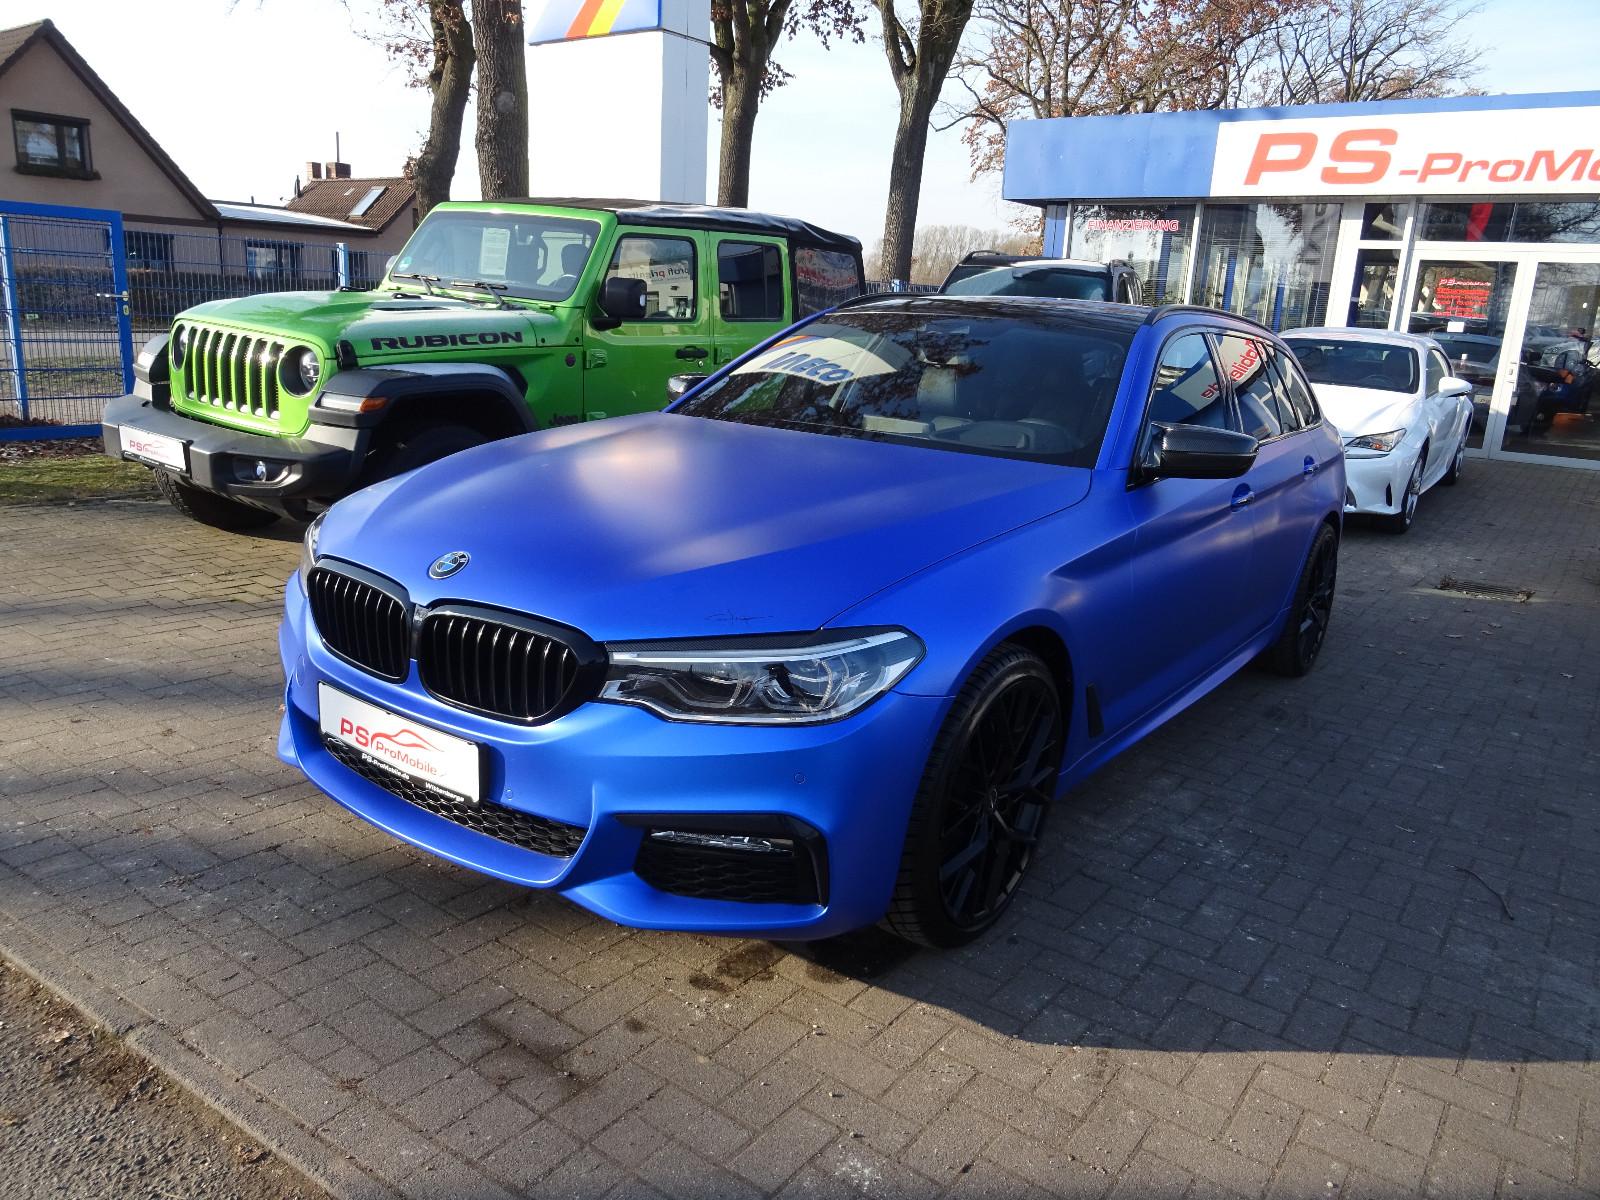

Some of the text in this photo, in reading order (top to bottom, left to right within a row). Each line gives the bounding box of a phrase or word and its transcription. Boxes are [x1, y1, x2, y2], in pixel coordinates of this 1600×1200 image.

[1087, 219, 1179, 232] FINANZIERUNG
[370, 331, 523, 350] RUBICON
[129, 439, 143, 452] PS
[340, 717, 369, 748] PS
[361, 752, 410, 780] PS-ProMobile.de
[375, 741, 438, 777] ProMobile
